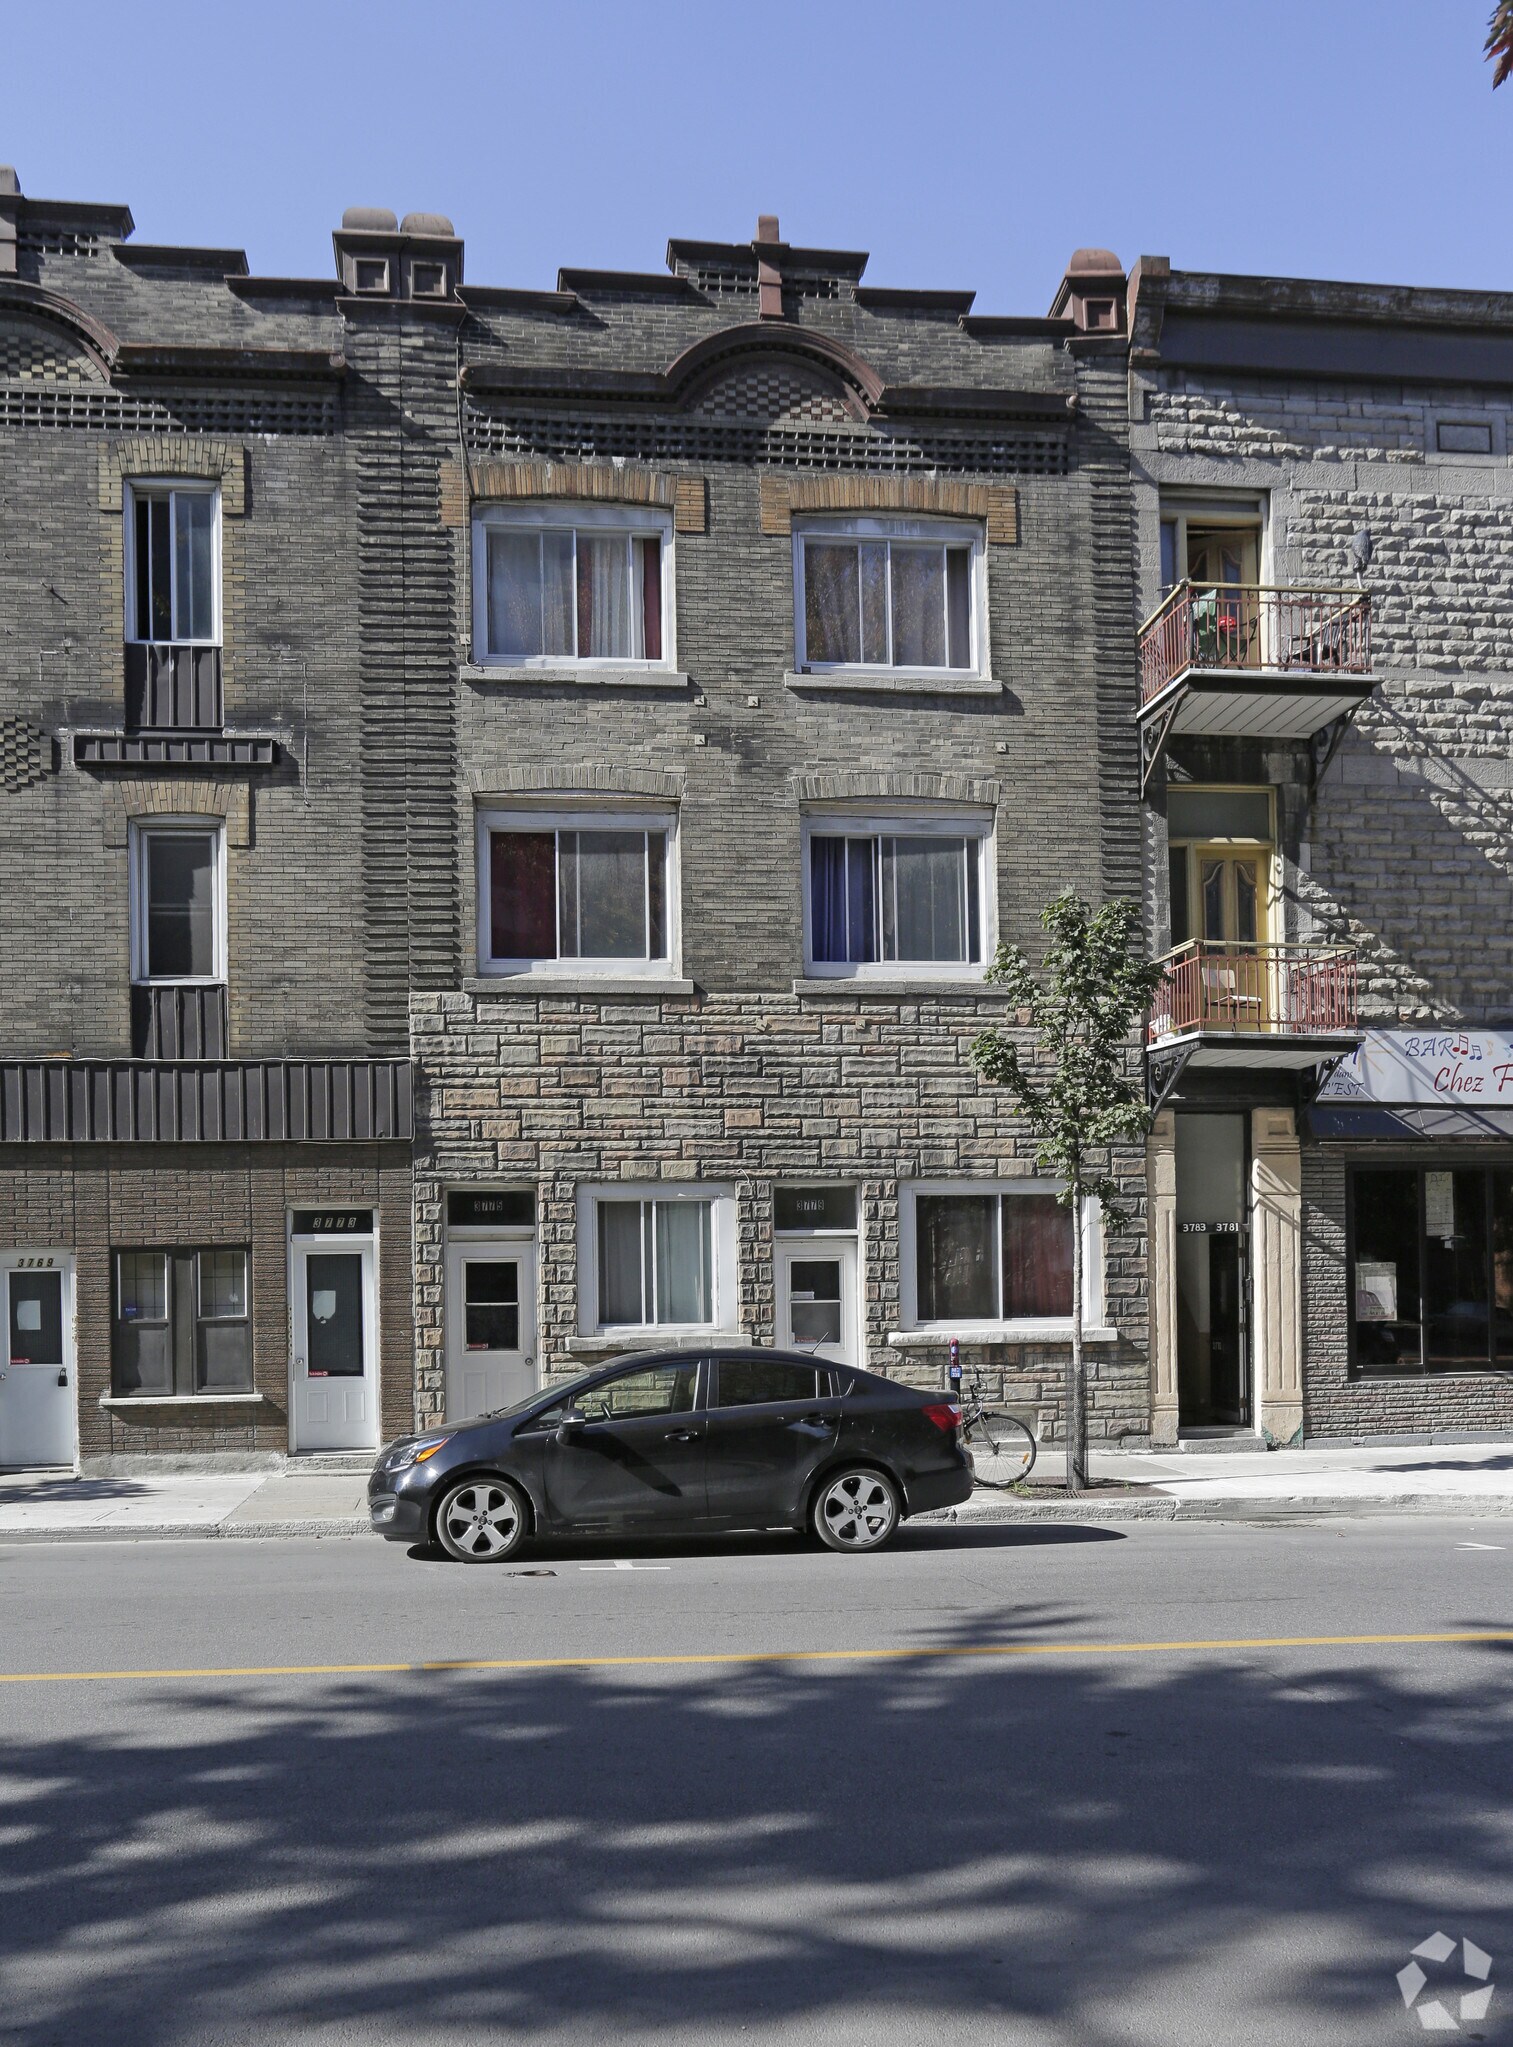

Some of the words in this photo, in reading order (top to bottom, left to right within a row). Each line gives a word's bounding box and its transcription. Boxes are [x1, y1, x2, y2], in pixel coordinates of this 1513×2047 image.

[1405, 1037, 1457, 1059] BAR
[1434, 1062, 1484, 1093] Chez
[1321, 1082, 1364, 1096] L'EST
[474, 1200, 503, 1212] 3775
[312, 1217, 357, 1229] 3773
[1182, 1222, 1207, 1232] 3783
[1216, 1222, 1239, 1232] 3781
[17, 1257, 55, 1268] 3769
